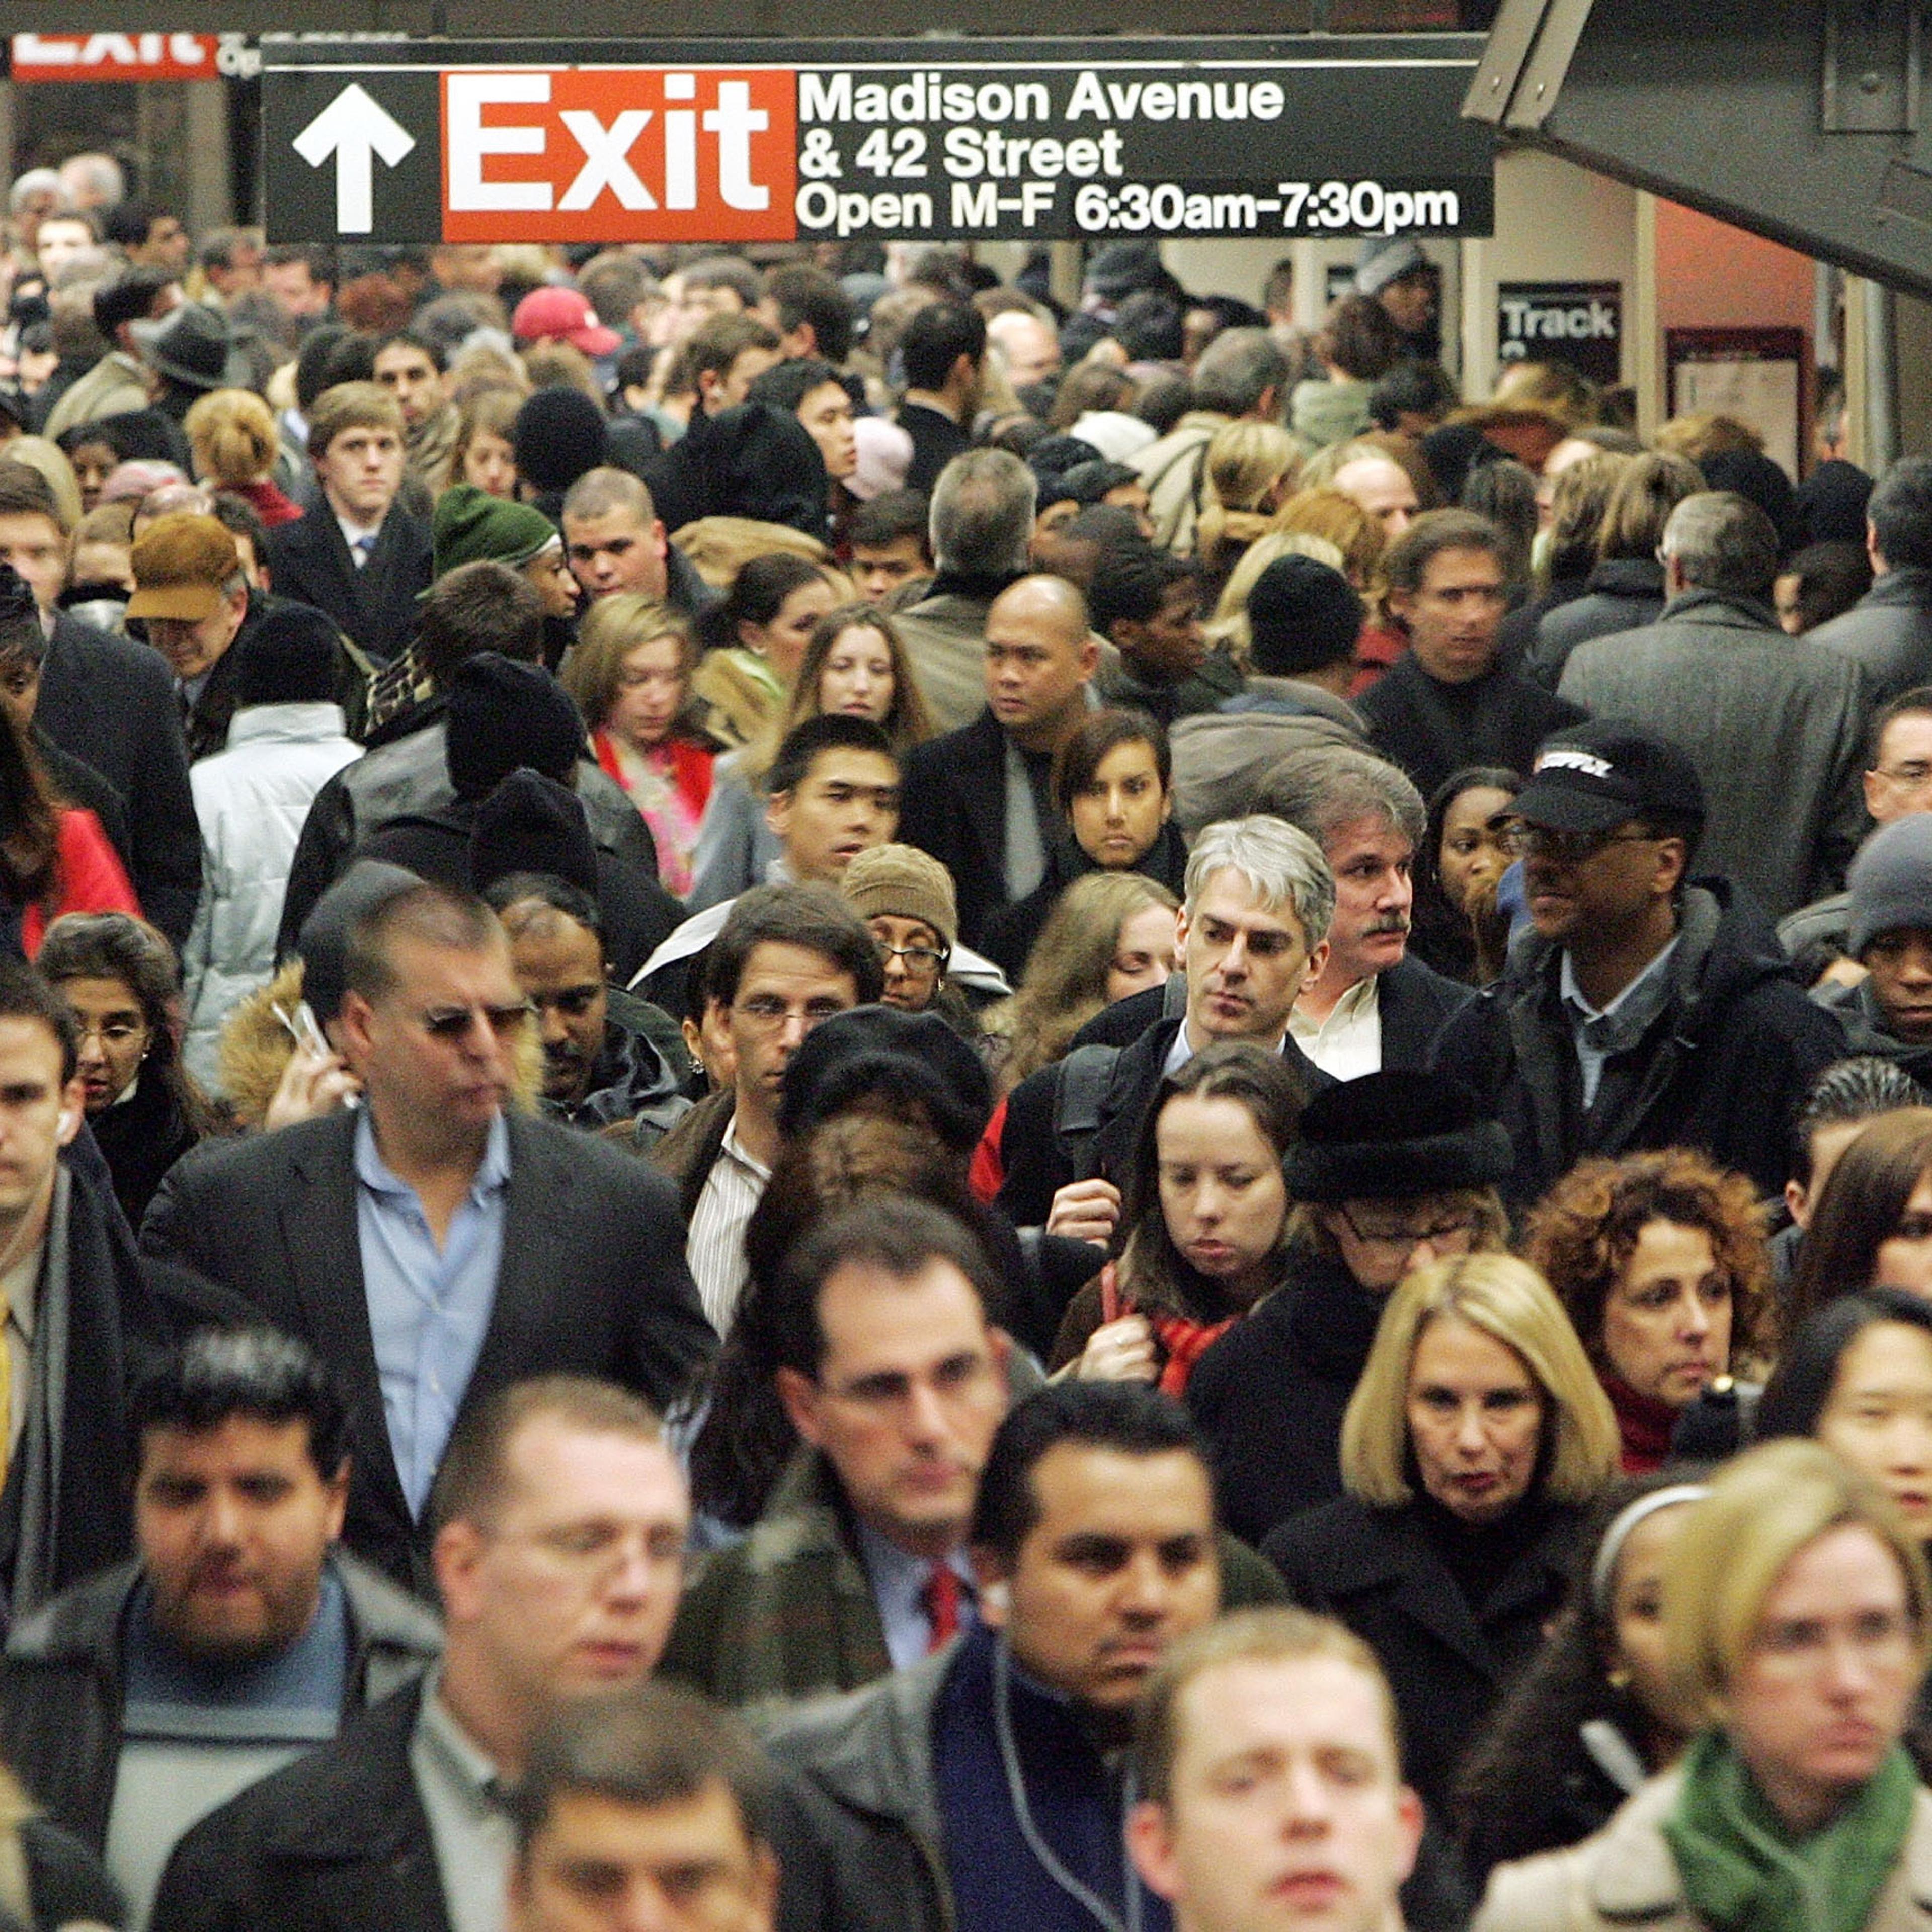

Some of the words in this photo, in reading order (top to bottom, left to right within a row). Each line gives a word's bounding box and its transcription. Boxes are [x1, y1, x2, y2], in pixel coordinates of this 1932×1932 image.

[798, 72, 1050, 122] Madison
[1065, 71, 1285, 121] Avenue
[447, 73, 769, 211] Exit
[799, 128, 843, 178] &
[856, 128, 927, 177] 42
[943, 127, 1123, 178] Street
[795, 182, 933, 237] Open
[951, 182, 1056, 228] M-F
[1075, 181, 1459, 235] 6:30am-7:30pm
[1501, 300, 1615, 338] Track
